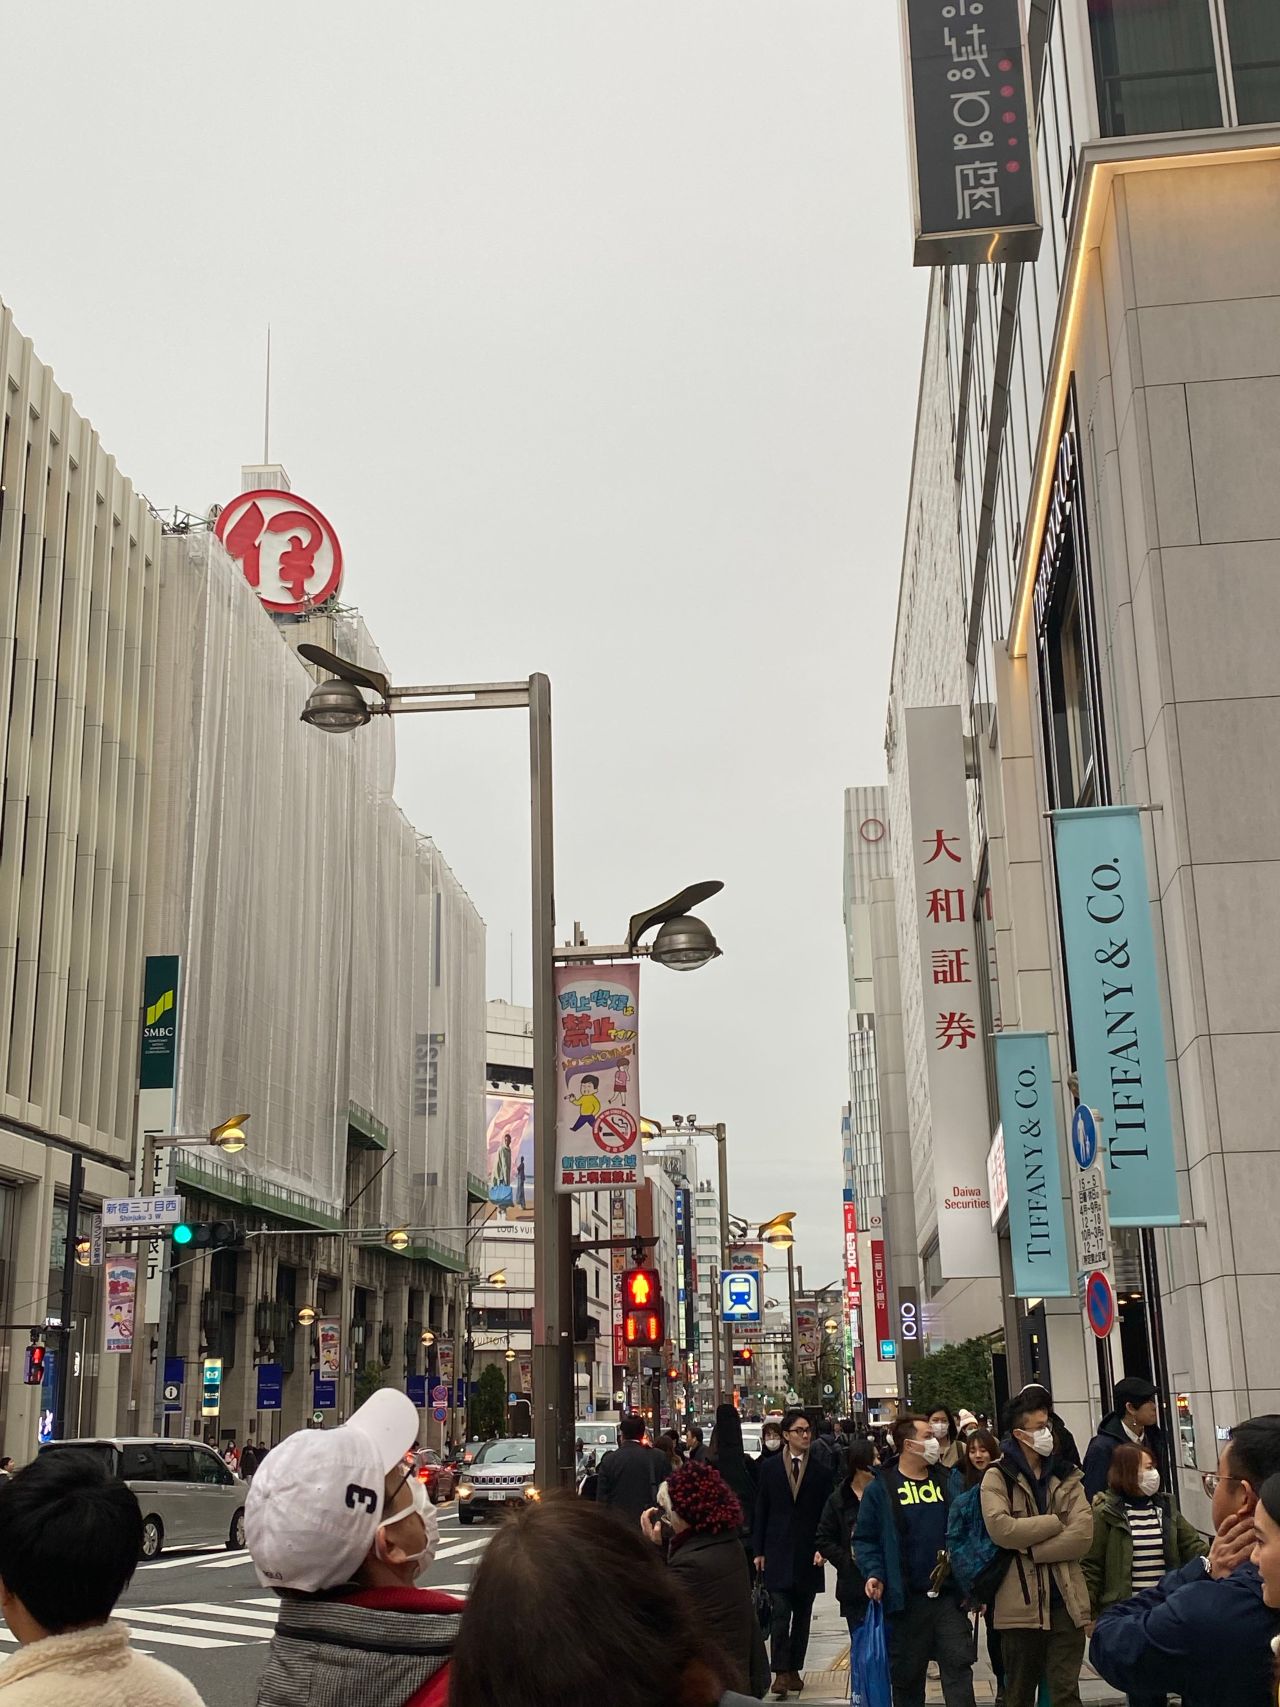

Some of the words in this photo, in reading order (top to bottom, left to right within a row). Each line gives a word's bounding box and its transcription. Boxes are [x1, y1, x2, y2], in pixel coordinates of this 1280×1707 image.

[922, 829, 976, 1050] 大和証券
[1094, 937, 1131, 969] &
[144, 1027, 174, 1037] SMBC
[1102, 978, 1150, 1170] TIFFANY
[1019, 1118, 1042, 1138] &
[944, 1198, 990, 1209] Securities
[953, 1186, 981, 1197] Daiwa
[1023, 1143, 1051, 1264] TIFFANY
[106, 1200, 177, 1214] 新宿三丁目西
[345, 1483, 378, 1514] 3
